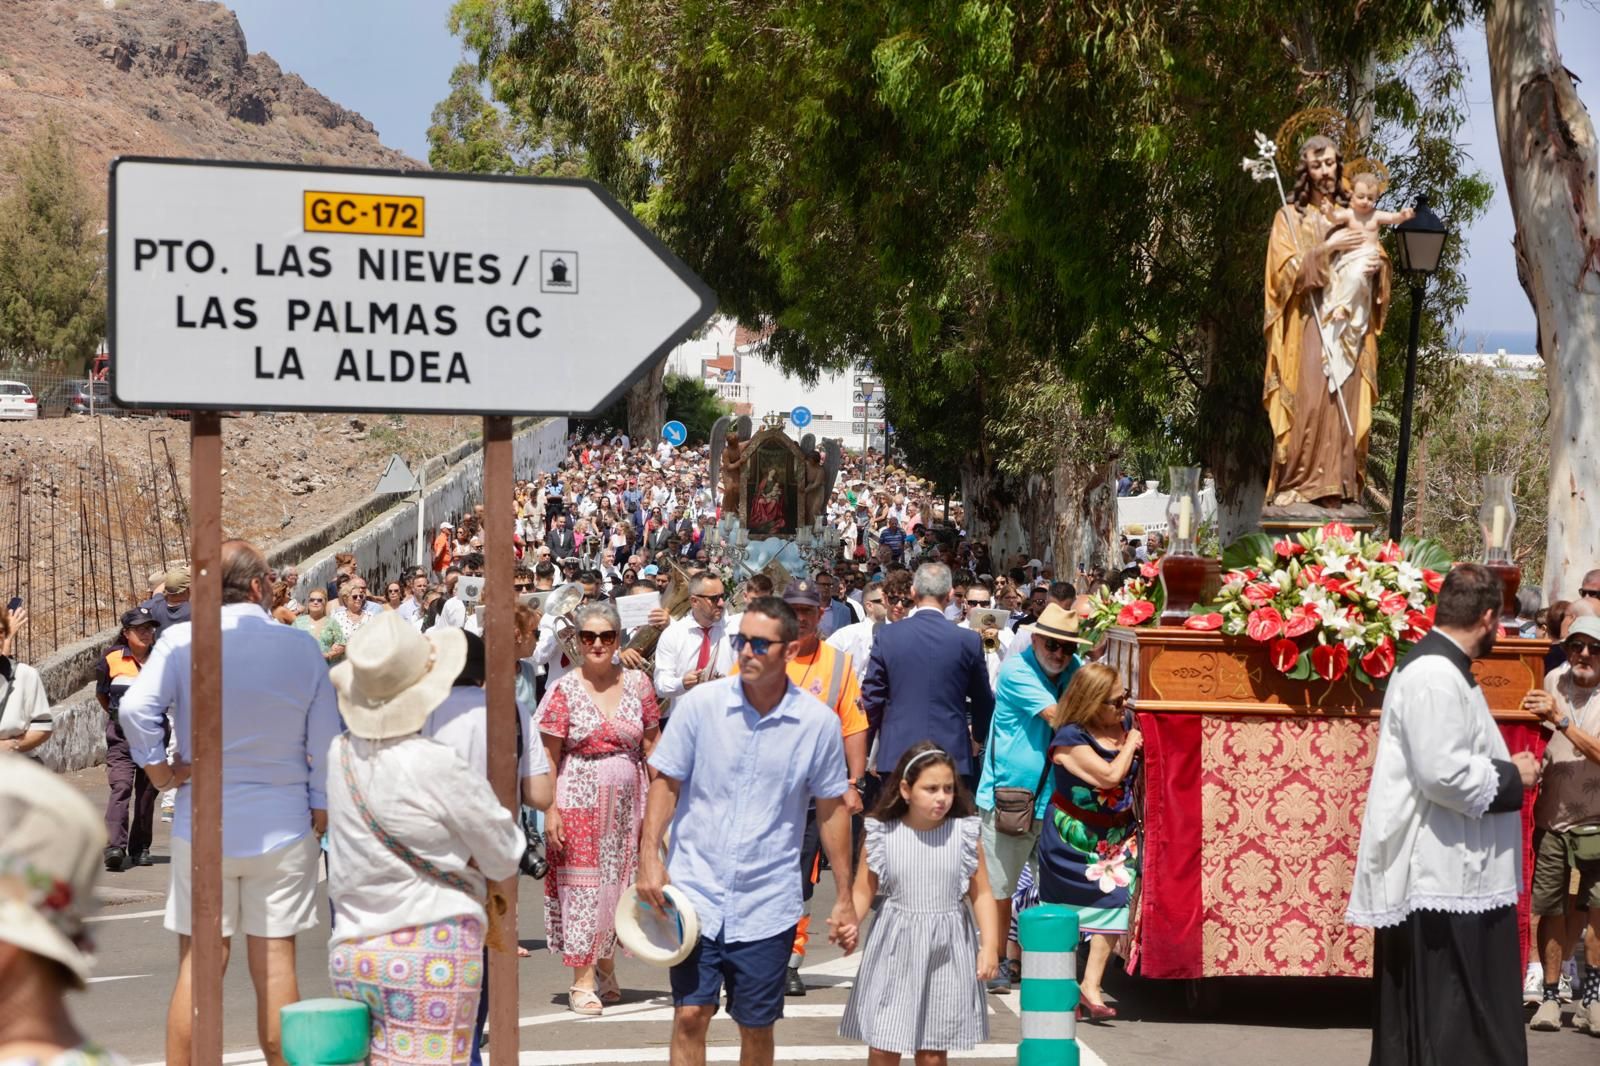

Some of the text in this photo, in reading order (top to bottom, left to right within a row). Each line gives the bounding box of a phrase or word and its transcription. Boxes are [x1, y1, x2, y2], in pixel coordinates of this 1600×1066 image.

[310, 198, 419, 230] GC-172
[134, 238, 230, 275] PTO.
[256, 243, 333, 279] LAS
[176, 295, 543, 339] LAS PALMAS GC
[255, 346, 472, 385] LA ALDEA
